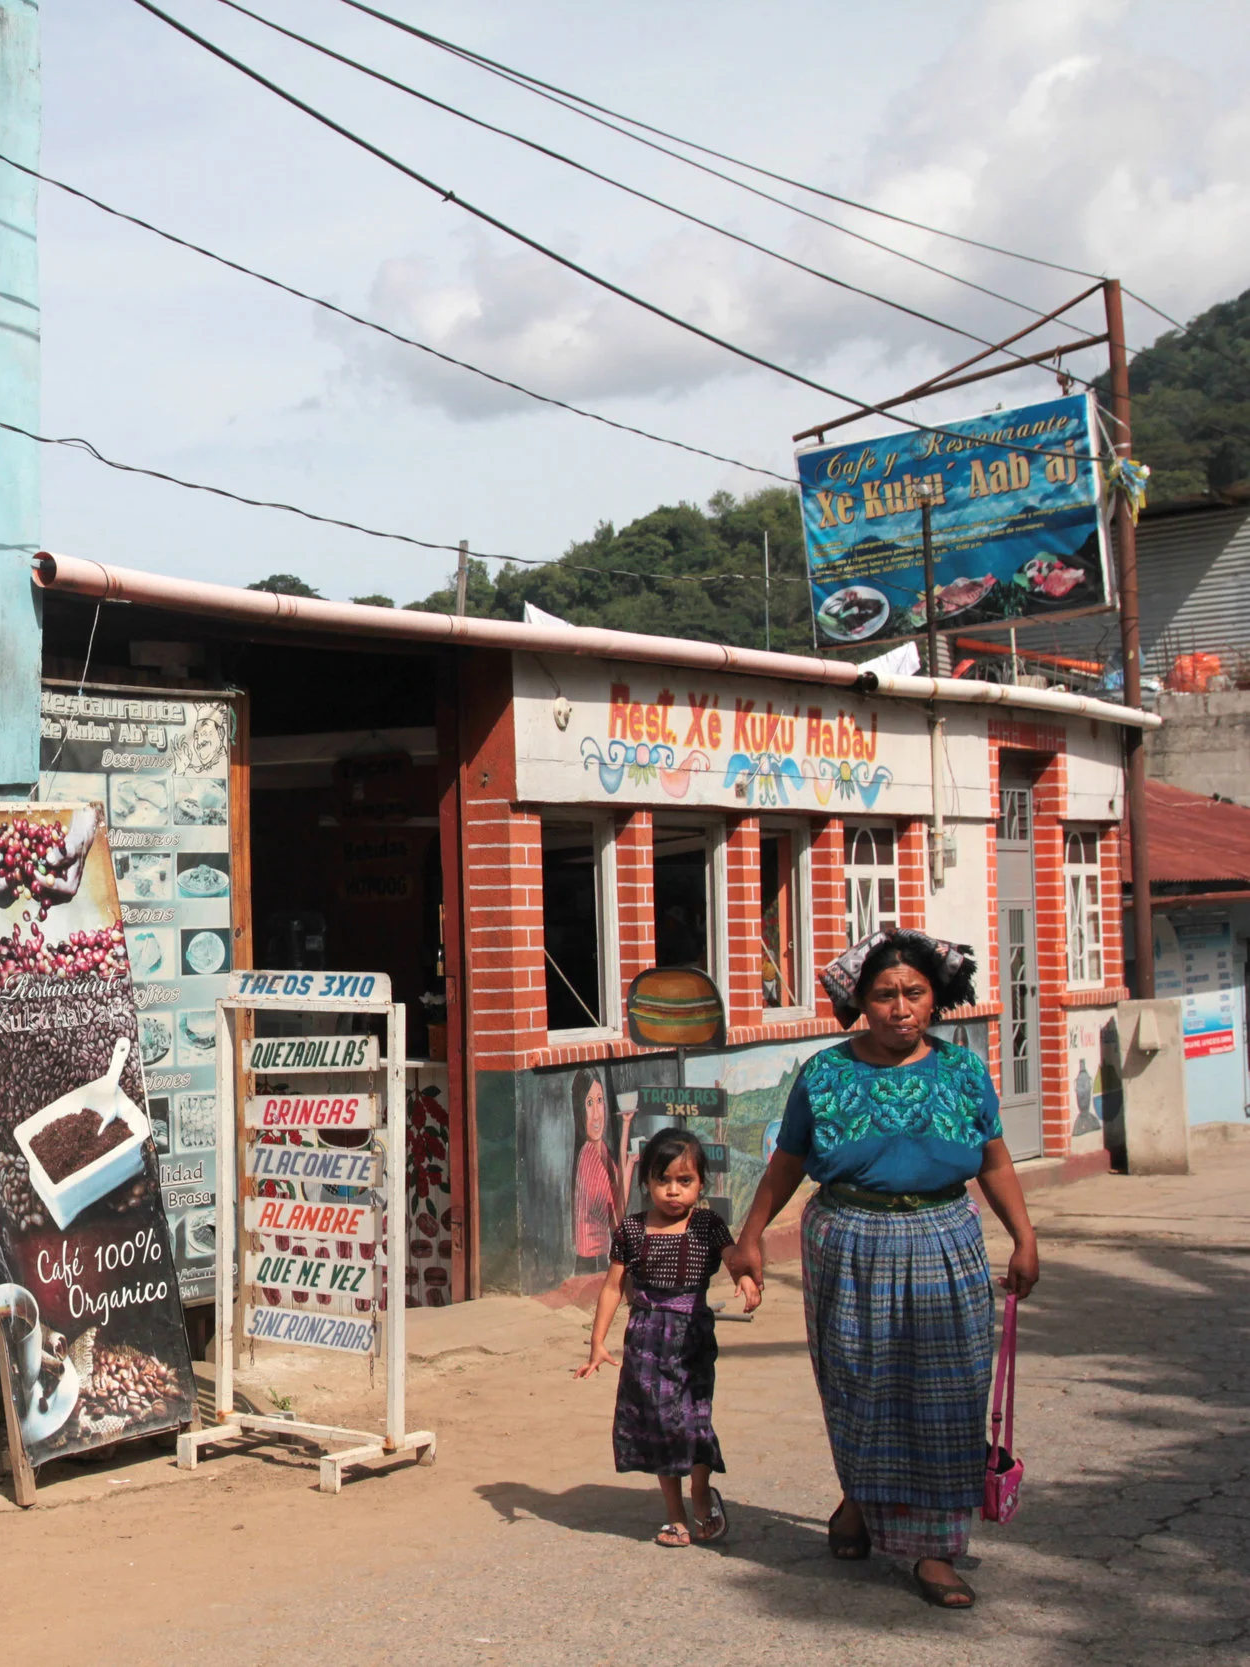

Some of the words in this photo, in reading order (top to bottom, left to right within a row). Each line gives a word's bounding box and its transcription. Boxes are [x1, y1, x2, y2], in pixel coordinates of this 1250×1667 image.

[816, 447, 876, 486] Café
[883, 451, 898, 478] y
[608, 682, 677, 745] Rest.
[101, 749, 173, 770] Desayunos
[108, 828, 181, 847] Almuerzos
[0, 968, 125, 1001] Restaurante
[238, 973, 315, 996] TACOS
[318, 974, 376, 998] 3X10
[249, 1038, 370, 1069] QUEZADILLAS
[262, 1098, 359, 1126] GRINGAS
[665, 1103, 700, 1116] 3X15
[251, 1147, 377, 1183] TLACONETE
[168, 1190, 212, 1209] Brasa
[258, 1202, 365, 1235] ALAMBRE
[37, 1240, 84, 1288] Café
[94, 1228, 163, 1273] 100%
[256, 1256, 296, 1284] QUE
[296, 1260, 326, 1288] ME
[329, 1263, 367, 1293] VEZ
[68, 1281, 168, 1326] Organico
[247, 1309, 377, 1352] SINCRONIZADAS
